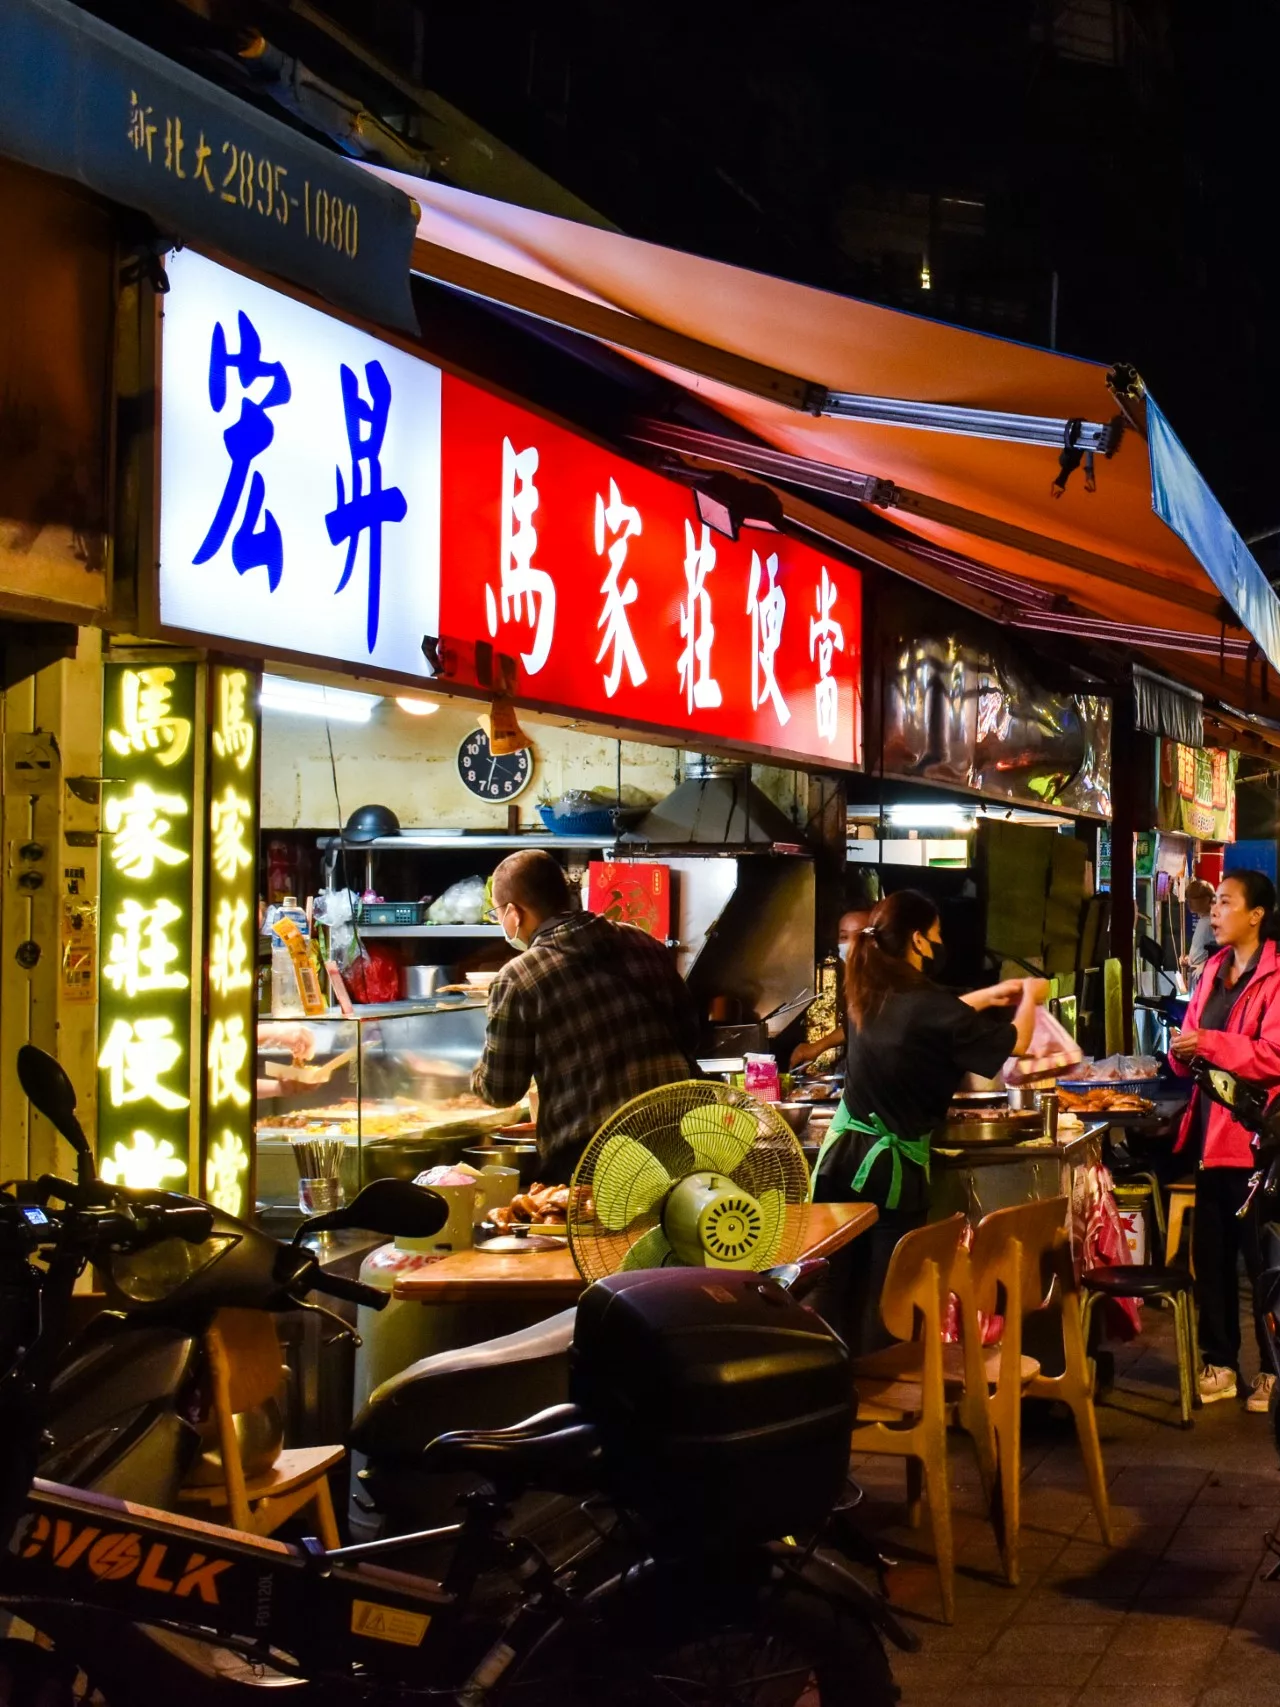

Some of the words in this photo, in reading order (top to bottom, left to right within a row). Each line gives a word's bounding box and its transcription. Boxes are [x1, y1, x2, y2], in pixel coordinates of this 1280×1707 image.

[485, 435, 844, 744] 馬家莊便當
[475, 734, 486, 745] 11
[467, 744, 479, 755] 10
[463, 756, 471, 767] 9
[518, 758, 526, 769] 3
[468, 770, 476, 781] 8
[514, 772, 522, 783] 4
[479, 780, 486, 791] 7
[490, 784, 499, 795] 6
[504, 781, 512, 792] 5
